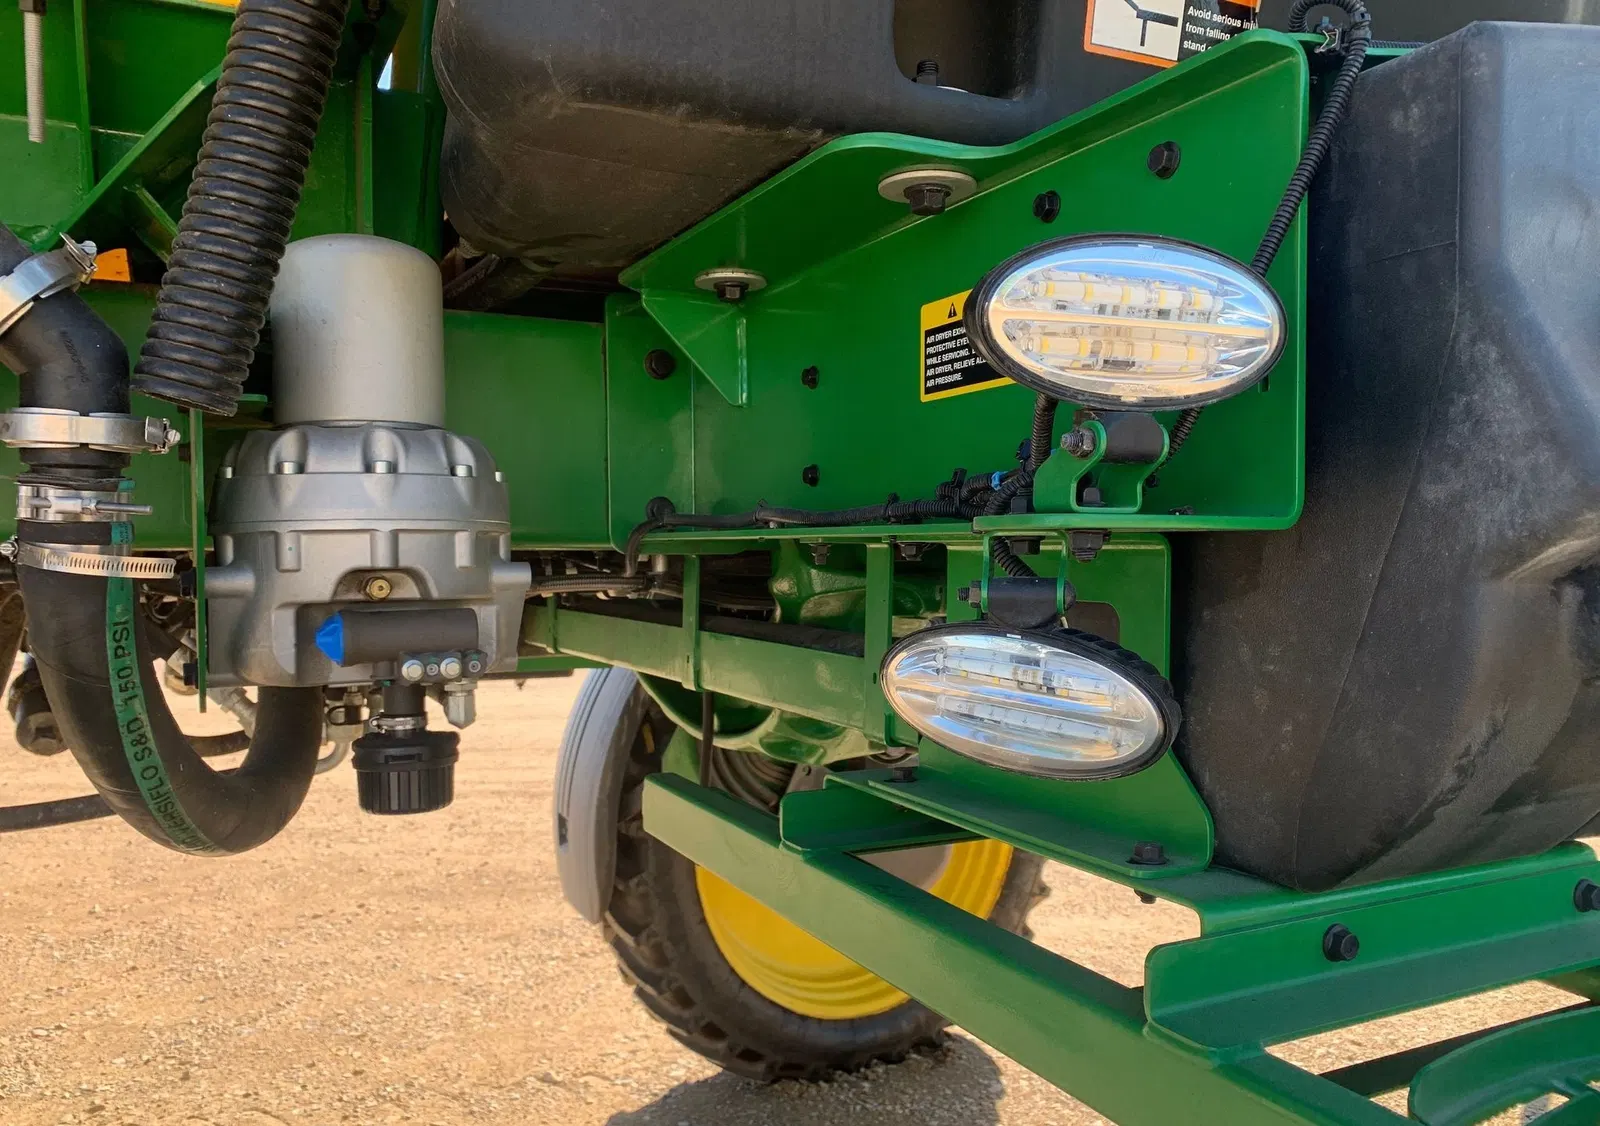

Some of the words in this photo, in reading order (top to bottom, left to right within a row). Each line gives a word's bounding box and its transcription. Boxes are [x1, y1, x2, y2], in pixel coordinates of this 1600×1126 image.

[1188, 6, 1211, 19] Avoid
[1212, 14, 1241, 27] serious
[1186, 22, 1204, 35] from
[1183, 40, 1205, 51] stand
[927, 336, 935, 344] AIR
[935, 330, 952, 341] DRYER
[953, 327, 966, 336] EXHA
[926, 341, 956, 355] PROTECTIVE
[926, 355, 941, 366] WHILE
[942, 348, 970, 363] SERVICING.
[926, 367, 935, 377] AIR
[935, 363, 953, 375] DRYER,
[953, 358, 975, 369] RELIEVE
[926, 379, 935, 388] AIR
[935, 372, 963, 386] PRESSURE.
[111, 619, 131, 659] PSI
[115, 666, 139, 705] 150
